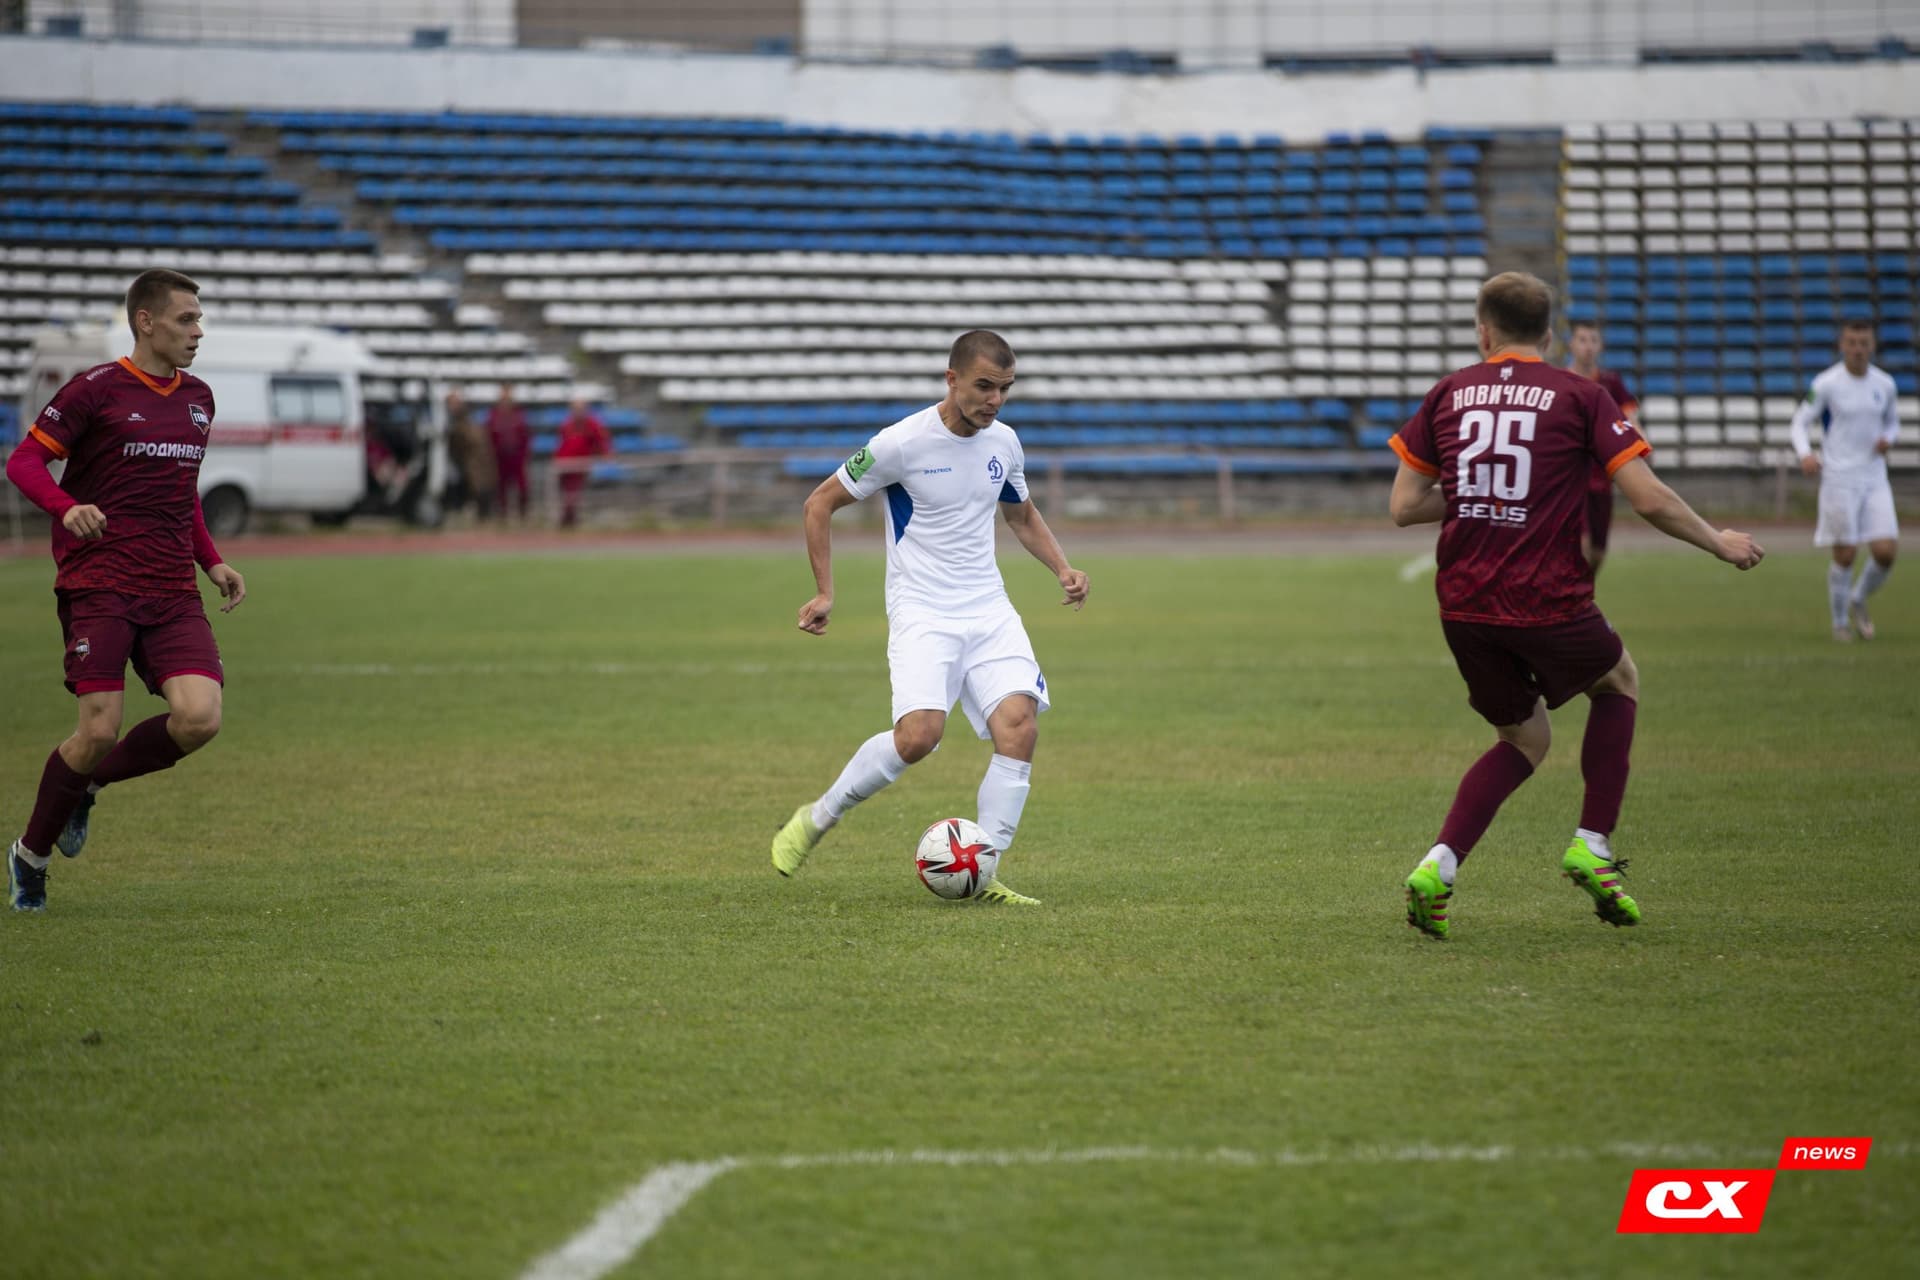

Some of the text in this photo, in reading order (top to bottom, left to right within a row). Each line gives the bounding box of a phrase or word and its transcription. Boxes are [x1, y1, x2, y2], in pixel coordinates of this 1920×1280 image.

[1453, 385, 1555, 411] НОВИЧКОВ
[1456, 410, 1537, 501] 25
[1458, 503, 1528, 522] SEUS
